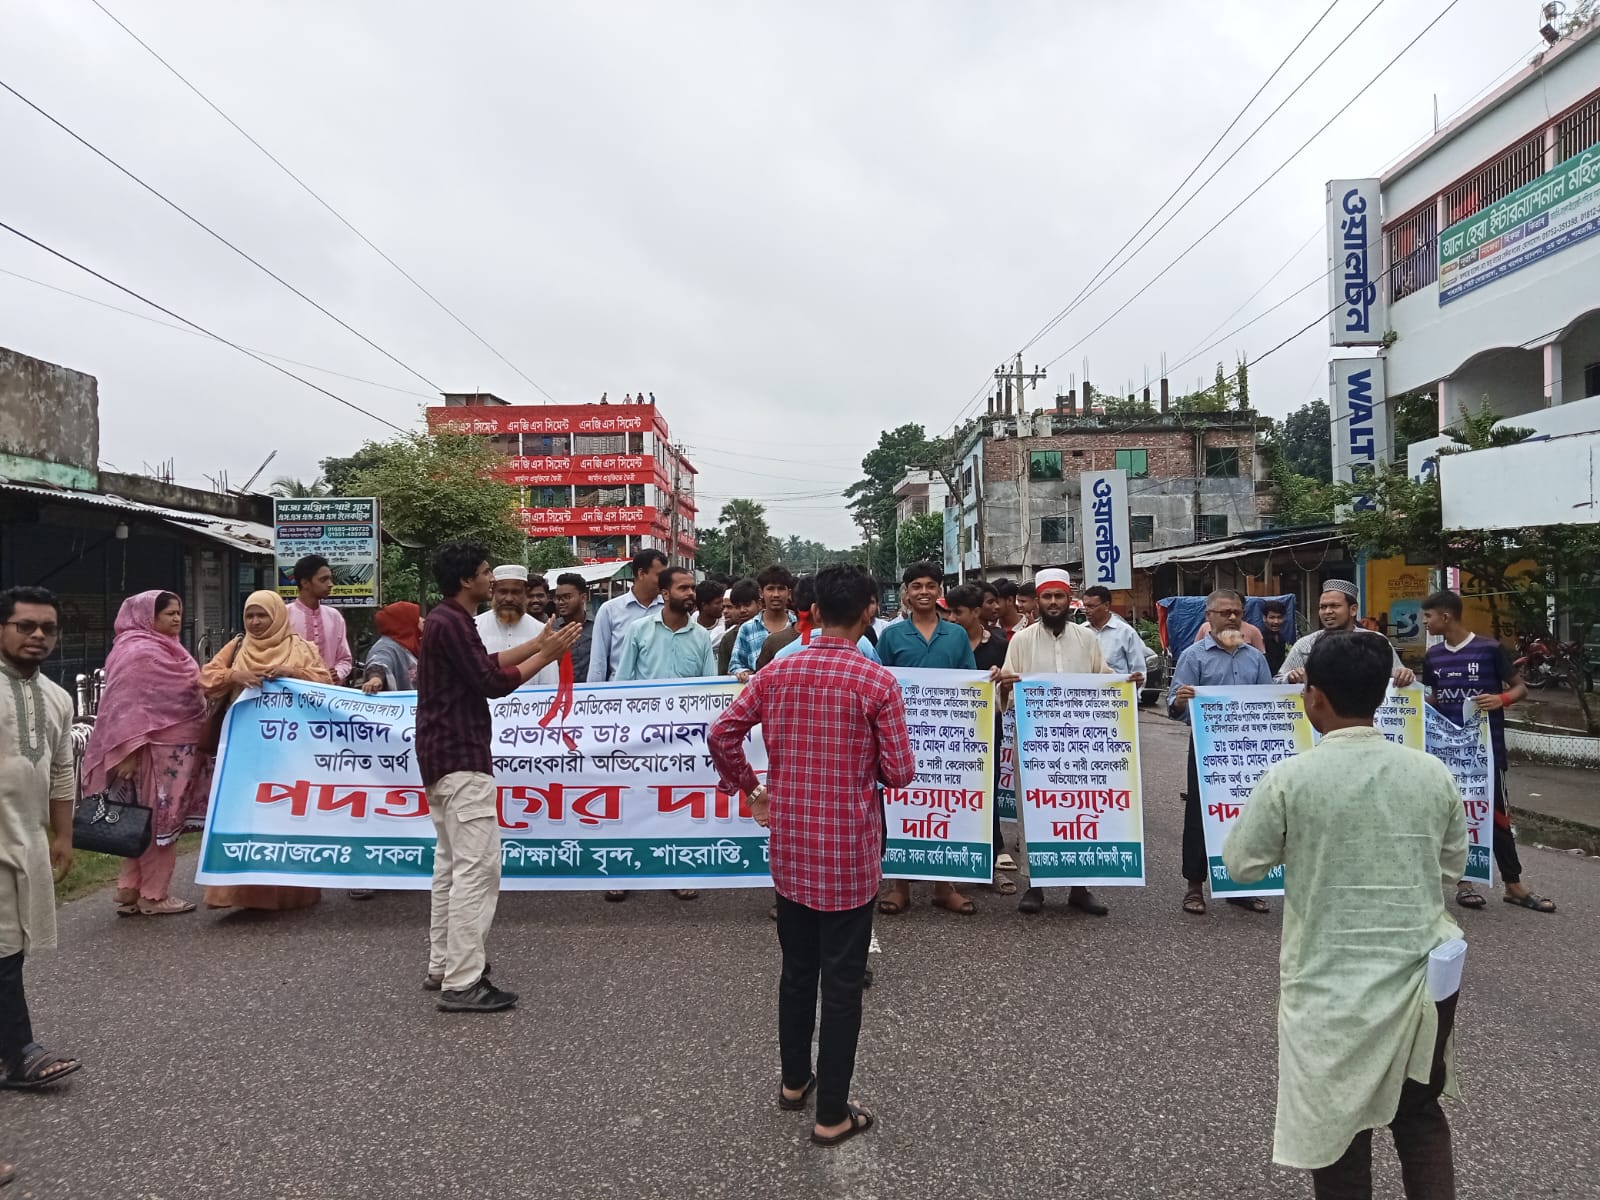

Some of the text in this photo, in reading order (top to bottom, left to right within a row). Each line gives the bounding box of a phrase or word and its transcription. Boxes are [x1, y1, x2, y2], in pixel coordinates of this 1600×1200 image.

[1442, 230, 1464, 256] আল
[1466, 217, 1487, 246] হেরা
[1490, 174, 1565, 233] ইন্টারন্যাশনাল
[1342, 189, 1376, 333] ওয়ালটন
[473, 419, 498, 433] সিমেন্ট
[544, 417, 569, 432] সিমেন্ট
[616, 416, 642, 430] সিমেন্ট
[545, 456, 570, 470] সিমেন্ট
[617, 456, 642, 469] সিমেন্ট
[546, 509, 572, 523] সিমেন্ট
[618, 508, 644, 521] সিমেন্ট
[1092, 478, 1120, 583] ওয়ালটন
[298, 690, 327, 712] গেইট
[573, 694, 622, 716] মেডিকেল
[626, 697, 661, 714] কলেজ
[665, 697, 674, 712] ও
[678, 693, 734, 713] হাসপাতাল
[971, 699, 988, 709] কলেজ
[1111, 700, 1129, 709] কলেজ
[258, 717, 299, 742] ডাঃ
[307, 714, 394, 744] তামজিদ
[499, 724, 584, 748] প্রভাষক
[591, 722, 631, 744] ডাঃ
[640, 721, 709, 747] মোহন
[939, 725, 966, 739] হোসেন
[968, 727, 975, 738] ও
[1034, 722, 1118, 739] ডাঃ তামজিদ হোসেন ও
[923, 740, 945, 754] মোহন
[948, 741, 960, 753] এর
[963, 738, 989, 754] বিরুদ্ধে
[1023, 737, 1132, 754] প্রভাষক ডাঃ মোহন এর বিরুদ্ধে
[1213, 736, 1295, 753] ডাঃ তামজিদ হোসেন ও
[314, 748, 373, 772] আনিত
[378, 748, 412, 773] অর্থ
[590, 749, 697, 773] অভিযোগের
[927, 756, 943, 770] নারী
[1023, 756, 1129, 772] আনিত অর্থ ও নারী কেলেংকারী
[1202, 754, 1229, 768] প্রভাষক
[1230, 754, 1244, 767] ডাঃ
[1246, 754, 1269, 767] মোহন
[1048, 771, 1107, 785] অভিযোগের দায়ে
[1204, 771, 1226, 785] আনিত
[1244, 774, 1251, 783] ও
[1026, 788, 1133, 813] পদত্যাগের
[900, 812, 951, 840] দাবি
[1050, 813, 1100, 840] দাবি
[221, 839, 352, 865] আয়োজনেঃ
[364, 843, 424, 865] সকল
[501, 839, 583, 867] শিক্ষার্থী
[590, 846, 642, 875] বৃন্দ,
[650, 838, 750, 869] শাহরাস্তি,
[909, 848, 926, 865] সকল
[1060, 851, 1077, 866] সকল
